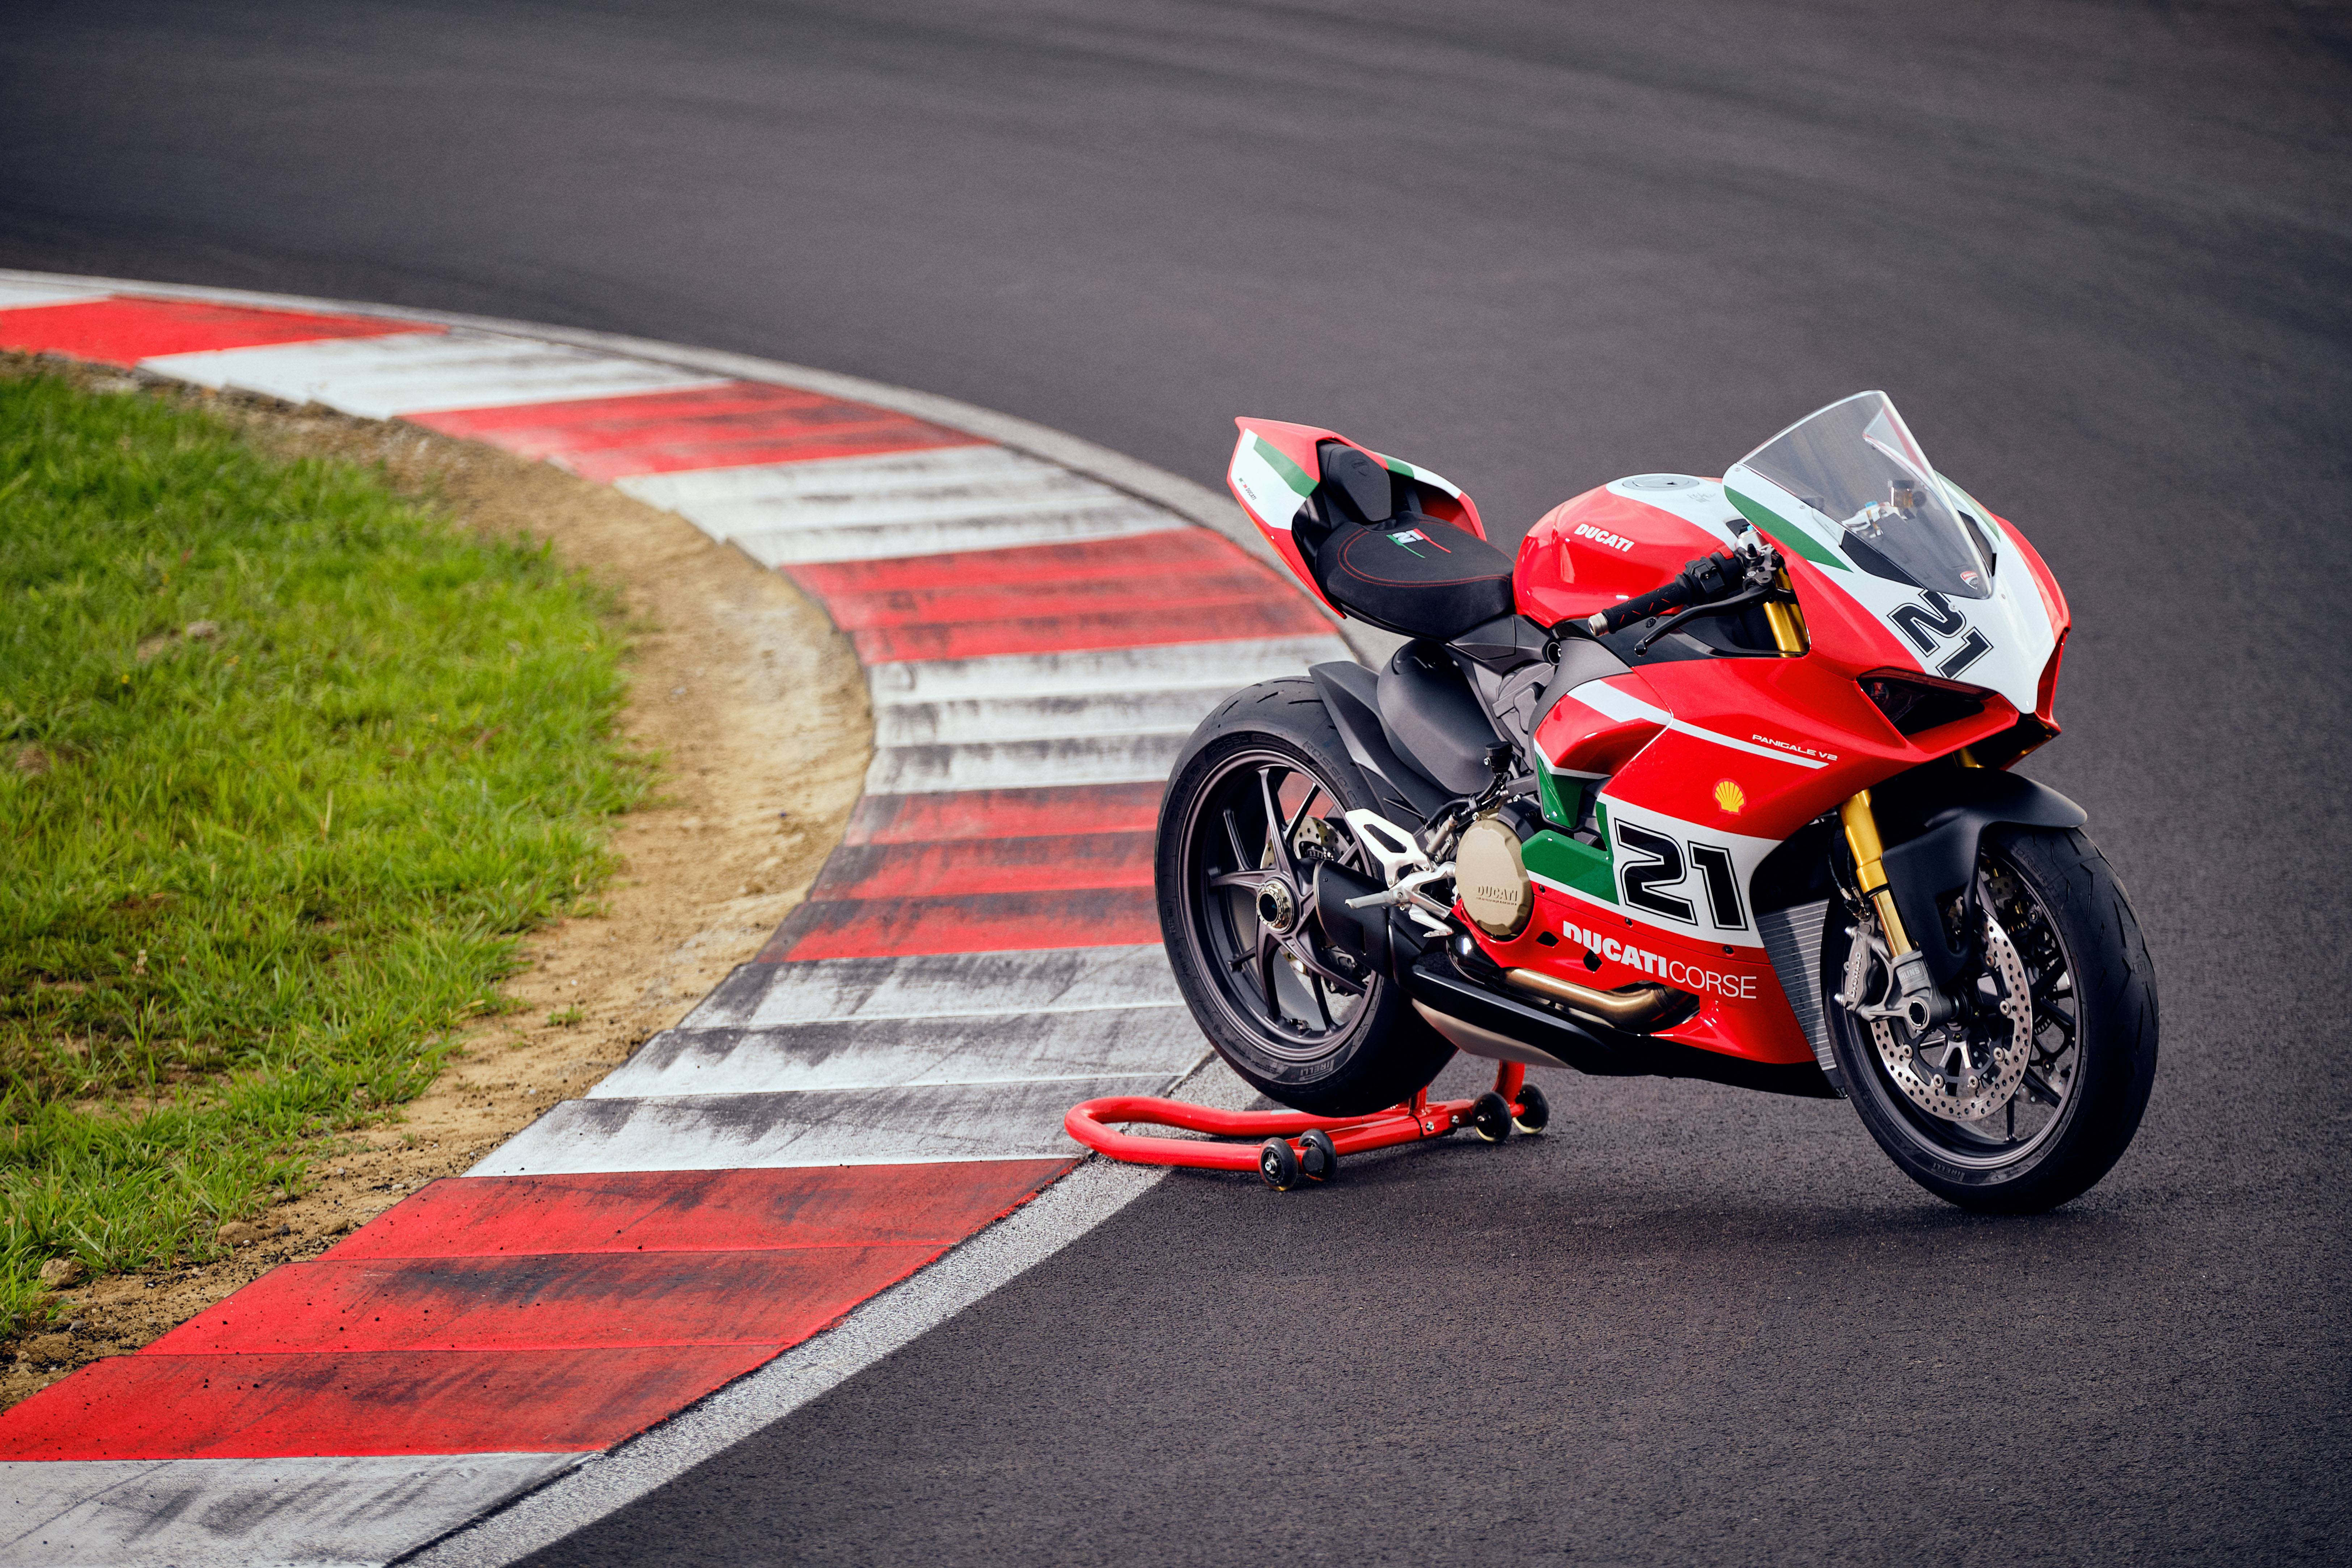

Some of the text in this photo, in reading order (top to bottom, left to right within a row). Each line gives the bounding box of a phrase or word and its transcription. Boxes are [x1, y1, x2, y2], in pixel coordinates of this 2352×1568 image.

[1245, 487, 1257, 500] DUCATI
[1392, 529, 1424, 544] 21
[1574, 523, 1635, 553] DUCATI
[1886, 588, 1994, 679] 21
[1208, 734, 1249, 757] ROSSO
[1752, 734, 1838, 761] PANIGALE V2
[1302, 740, 1349, 787] ROSSO
[1614, 817, 1750, 931] 21
[1476, 885, 1518, 902] DUCATI
[1847, 951, 1862, 999] brembo
[1299, 1059, 1335, 1082] PIRELLI
[1932, 1162, 1965, 1182] PIRELLI
